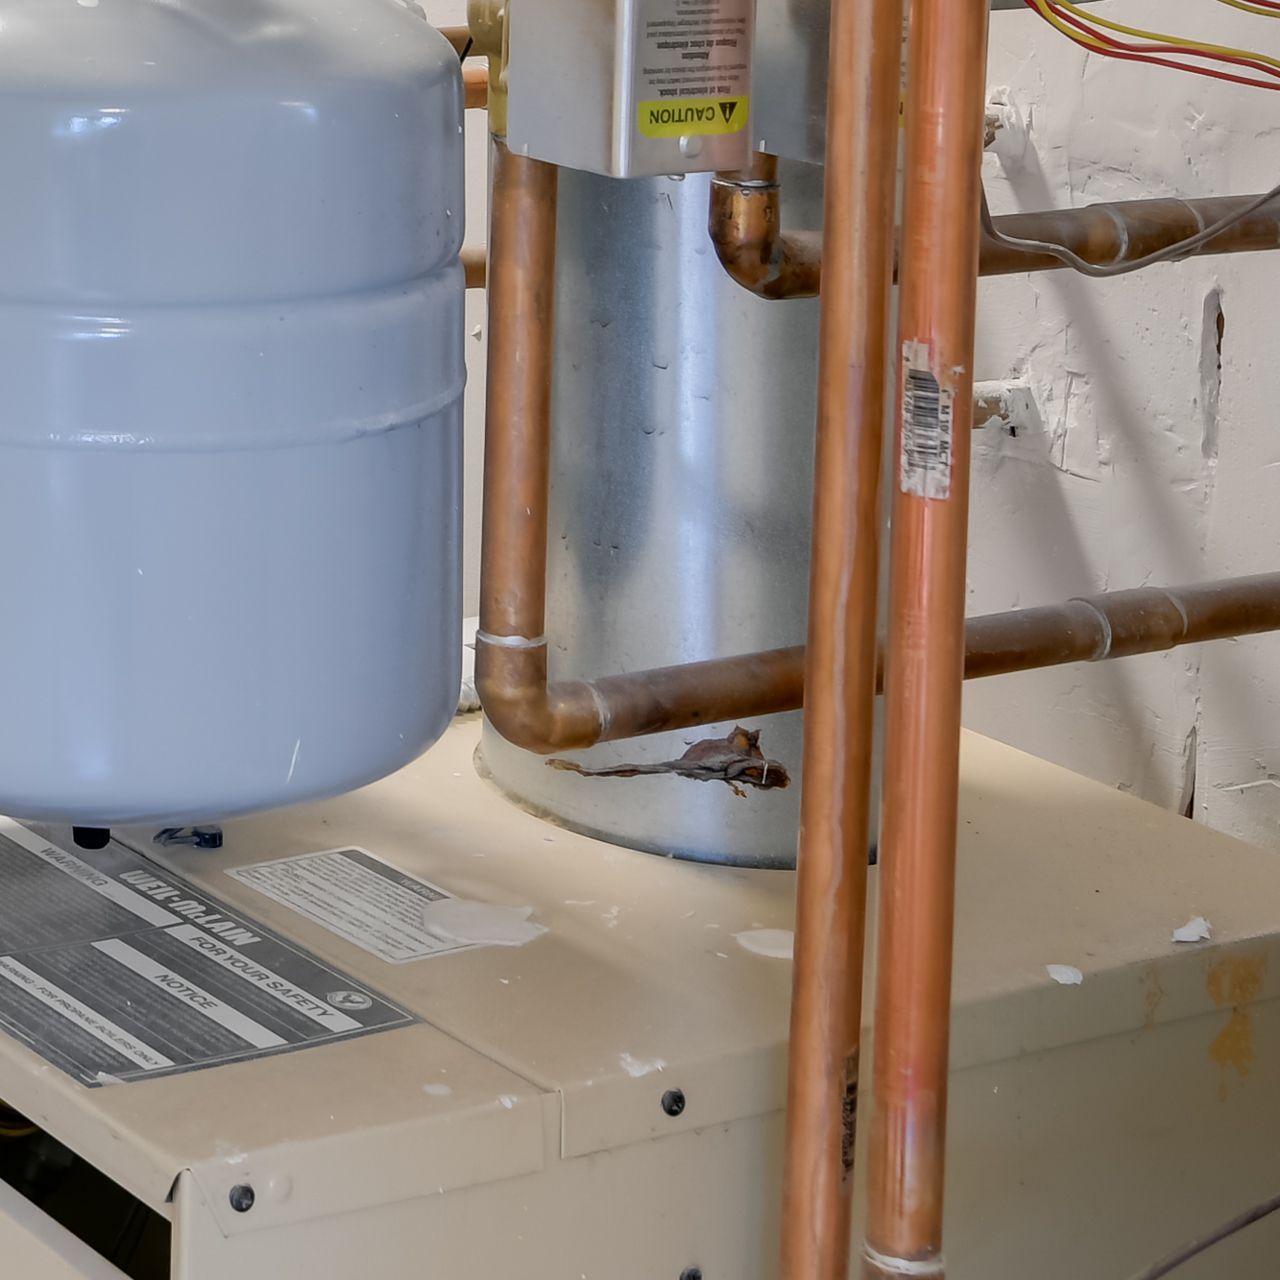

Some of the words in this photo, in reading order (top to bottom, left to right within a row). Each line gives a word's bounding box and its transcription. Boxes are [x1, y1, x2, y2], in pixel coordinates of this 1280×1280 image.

[649, 107, 715, 124] CAUTION
[40, 847, 107, 888] WARNING
[154, 973, 219, 1011] NOTICE
[189, 935, 226, 958] FOR
[227, 955, 272, 983] YOUR
[265, 975, 335, 1020] SAFETY
